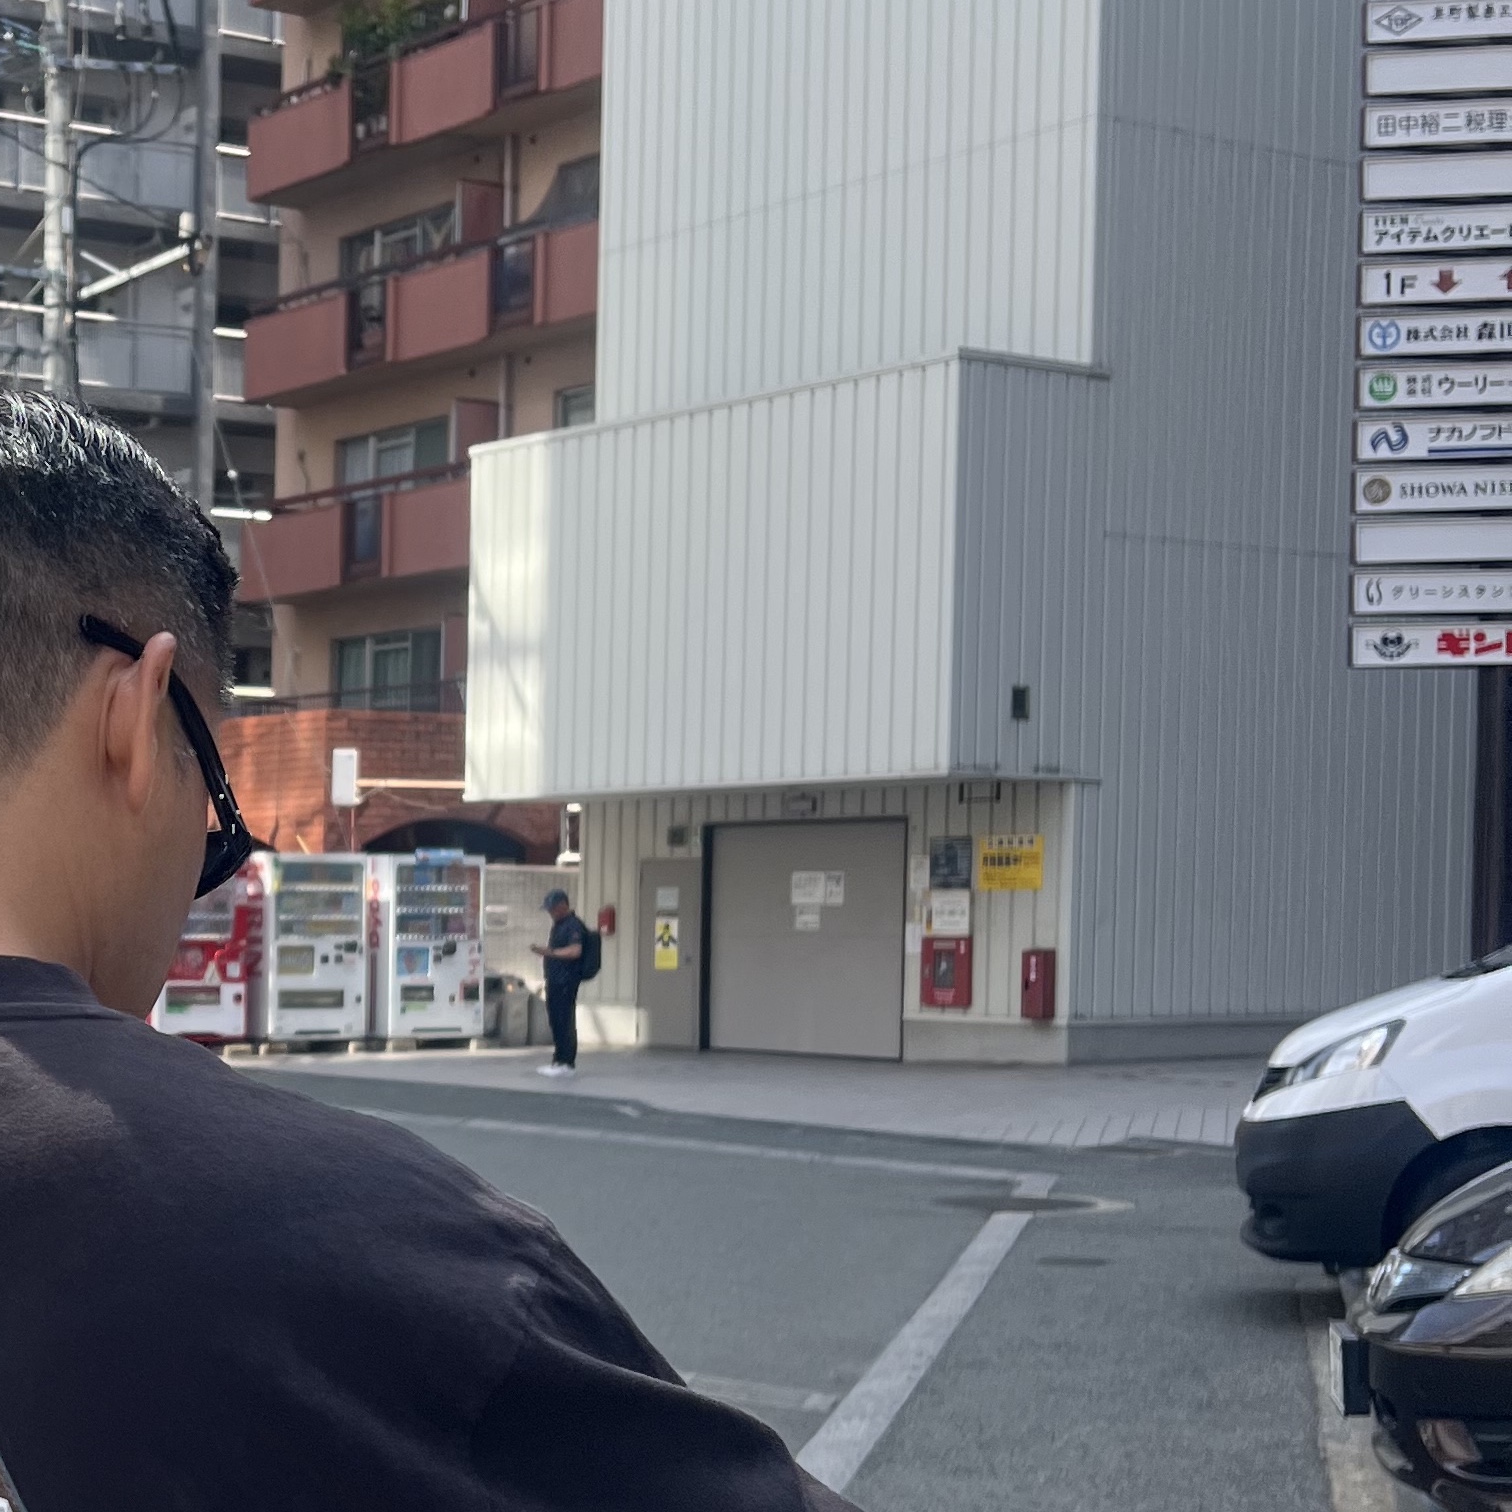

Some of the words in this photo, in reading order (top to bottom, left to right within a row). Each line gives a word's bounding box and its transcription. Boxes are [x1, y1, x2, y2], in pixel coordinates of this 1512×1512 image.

[1376, 109, 1512, 138] 田中裕二税理
[1385, 270, 1418, 297] 1F
[1406, 323, 1469, 343] 株式会社
[1437, 374, 1512, 396] ウーリー
[1400, 481, 1468, 499] SHOWA
[1391, 583, 1512, 601] グリーンスタン
